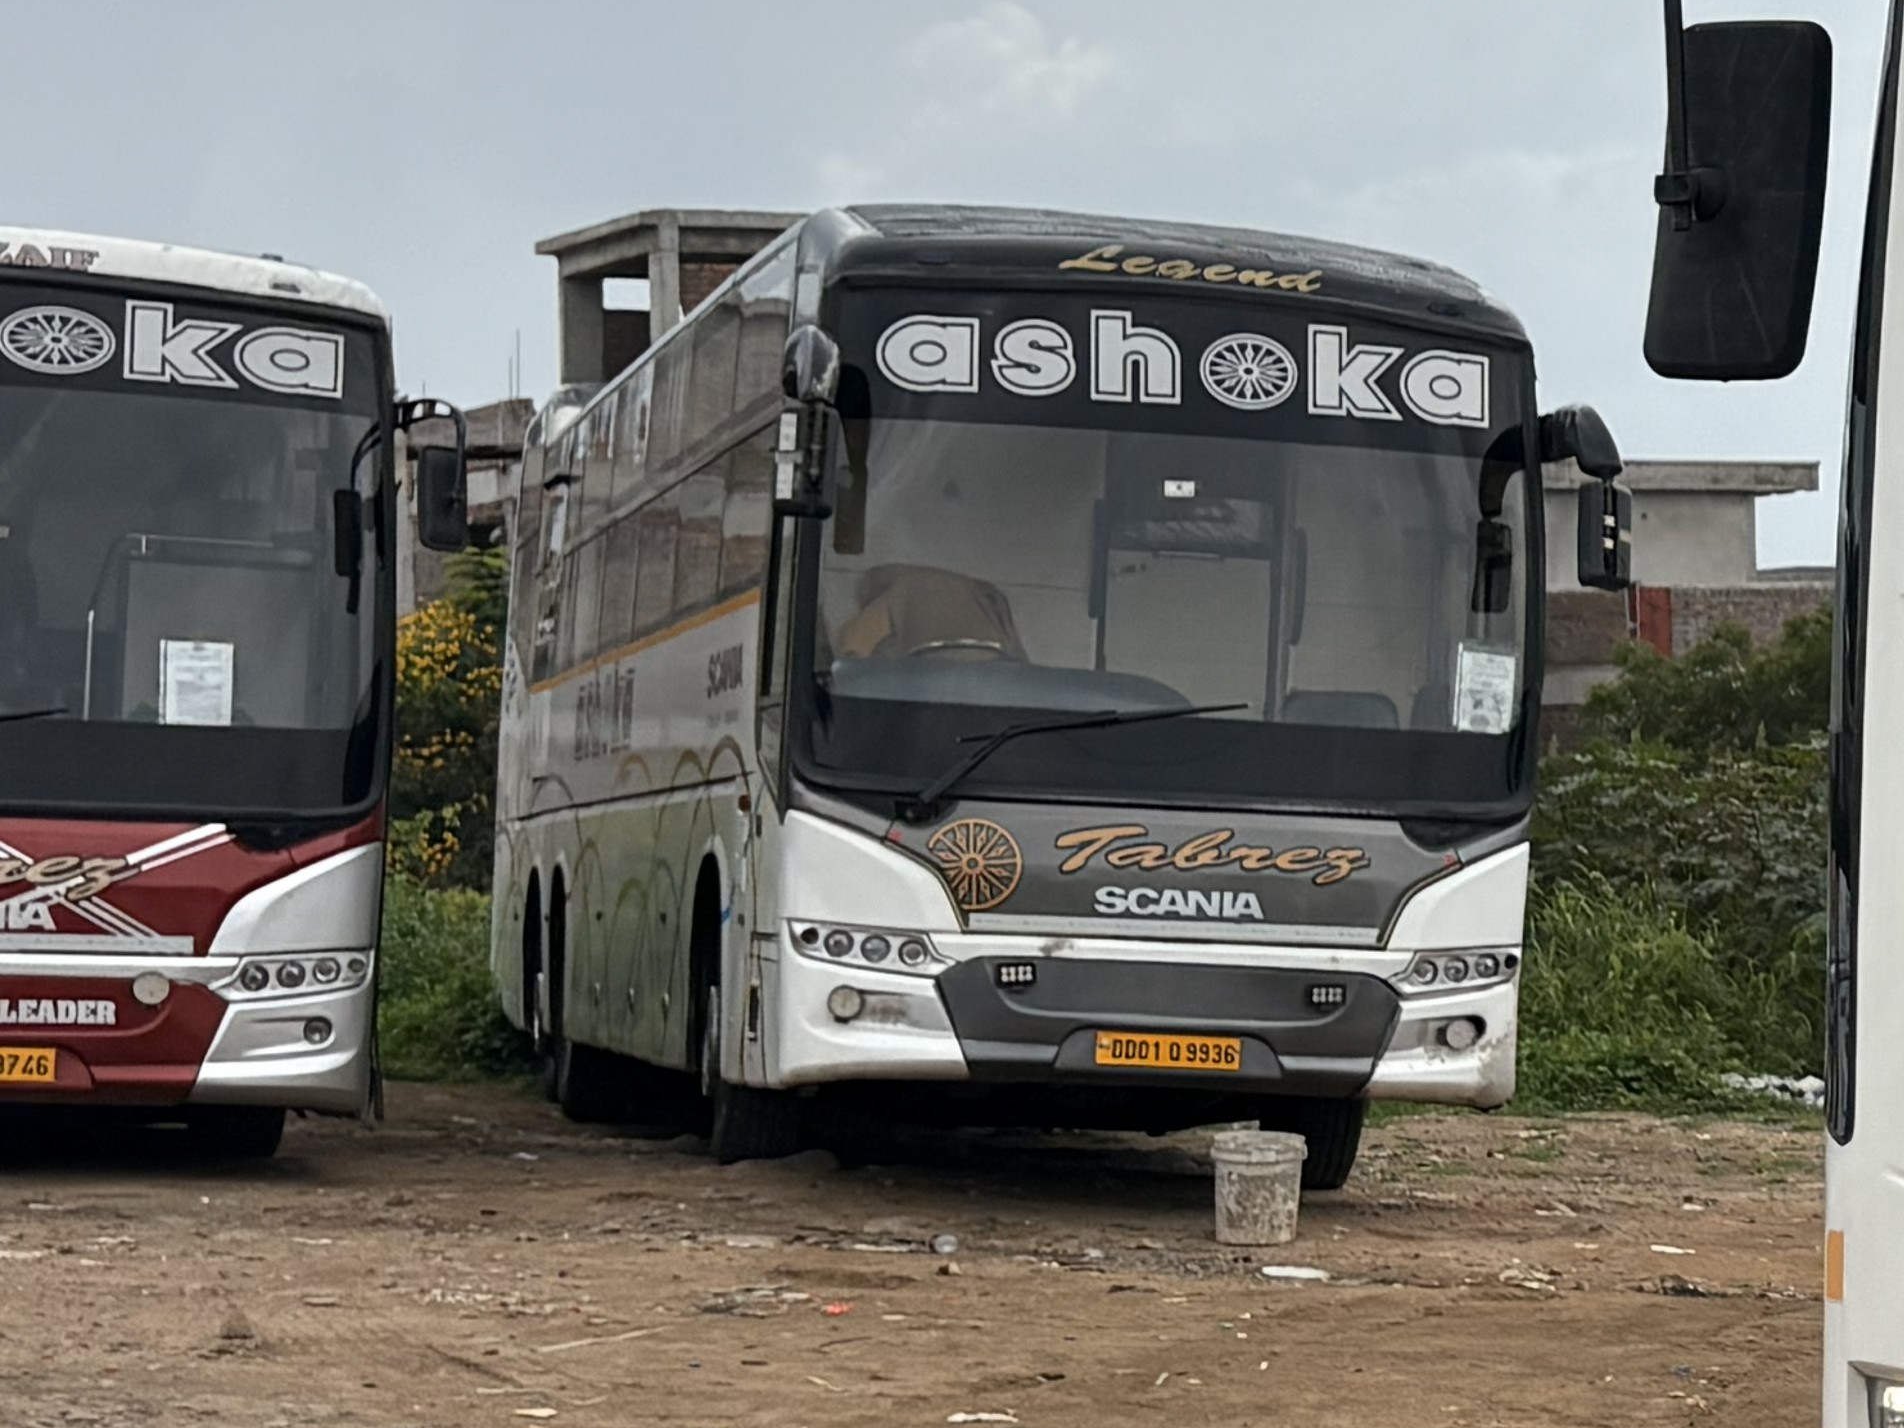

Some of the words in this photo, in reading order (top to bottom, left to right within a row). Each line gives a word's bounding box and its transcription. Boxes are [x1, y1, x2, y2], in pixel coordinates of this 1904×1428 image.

[1058, 245, 1322, 293] Legend
[875, 309, 1490, 430] ashoka
[1054, 823, 1371, 885] Tabrez
[1094, 886, 1265, 920] SCANIA
[0, 999, 116, 1025] LEADER
[1186, 1043, 1236, 1064] 9936
